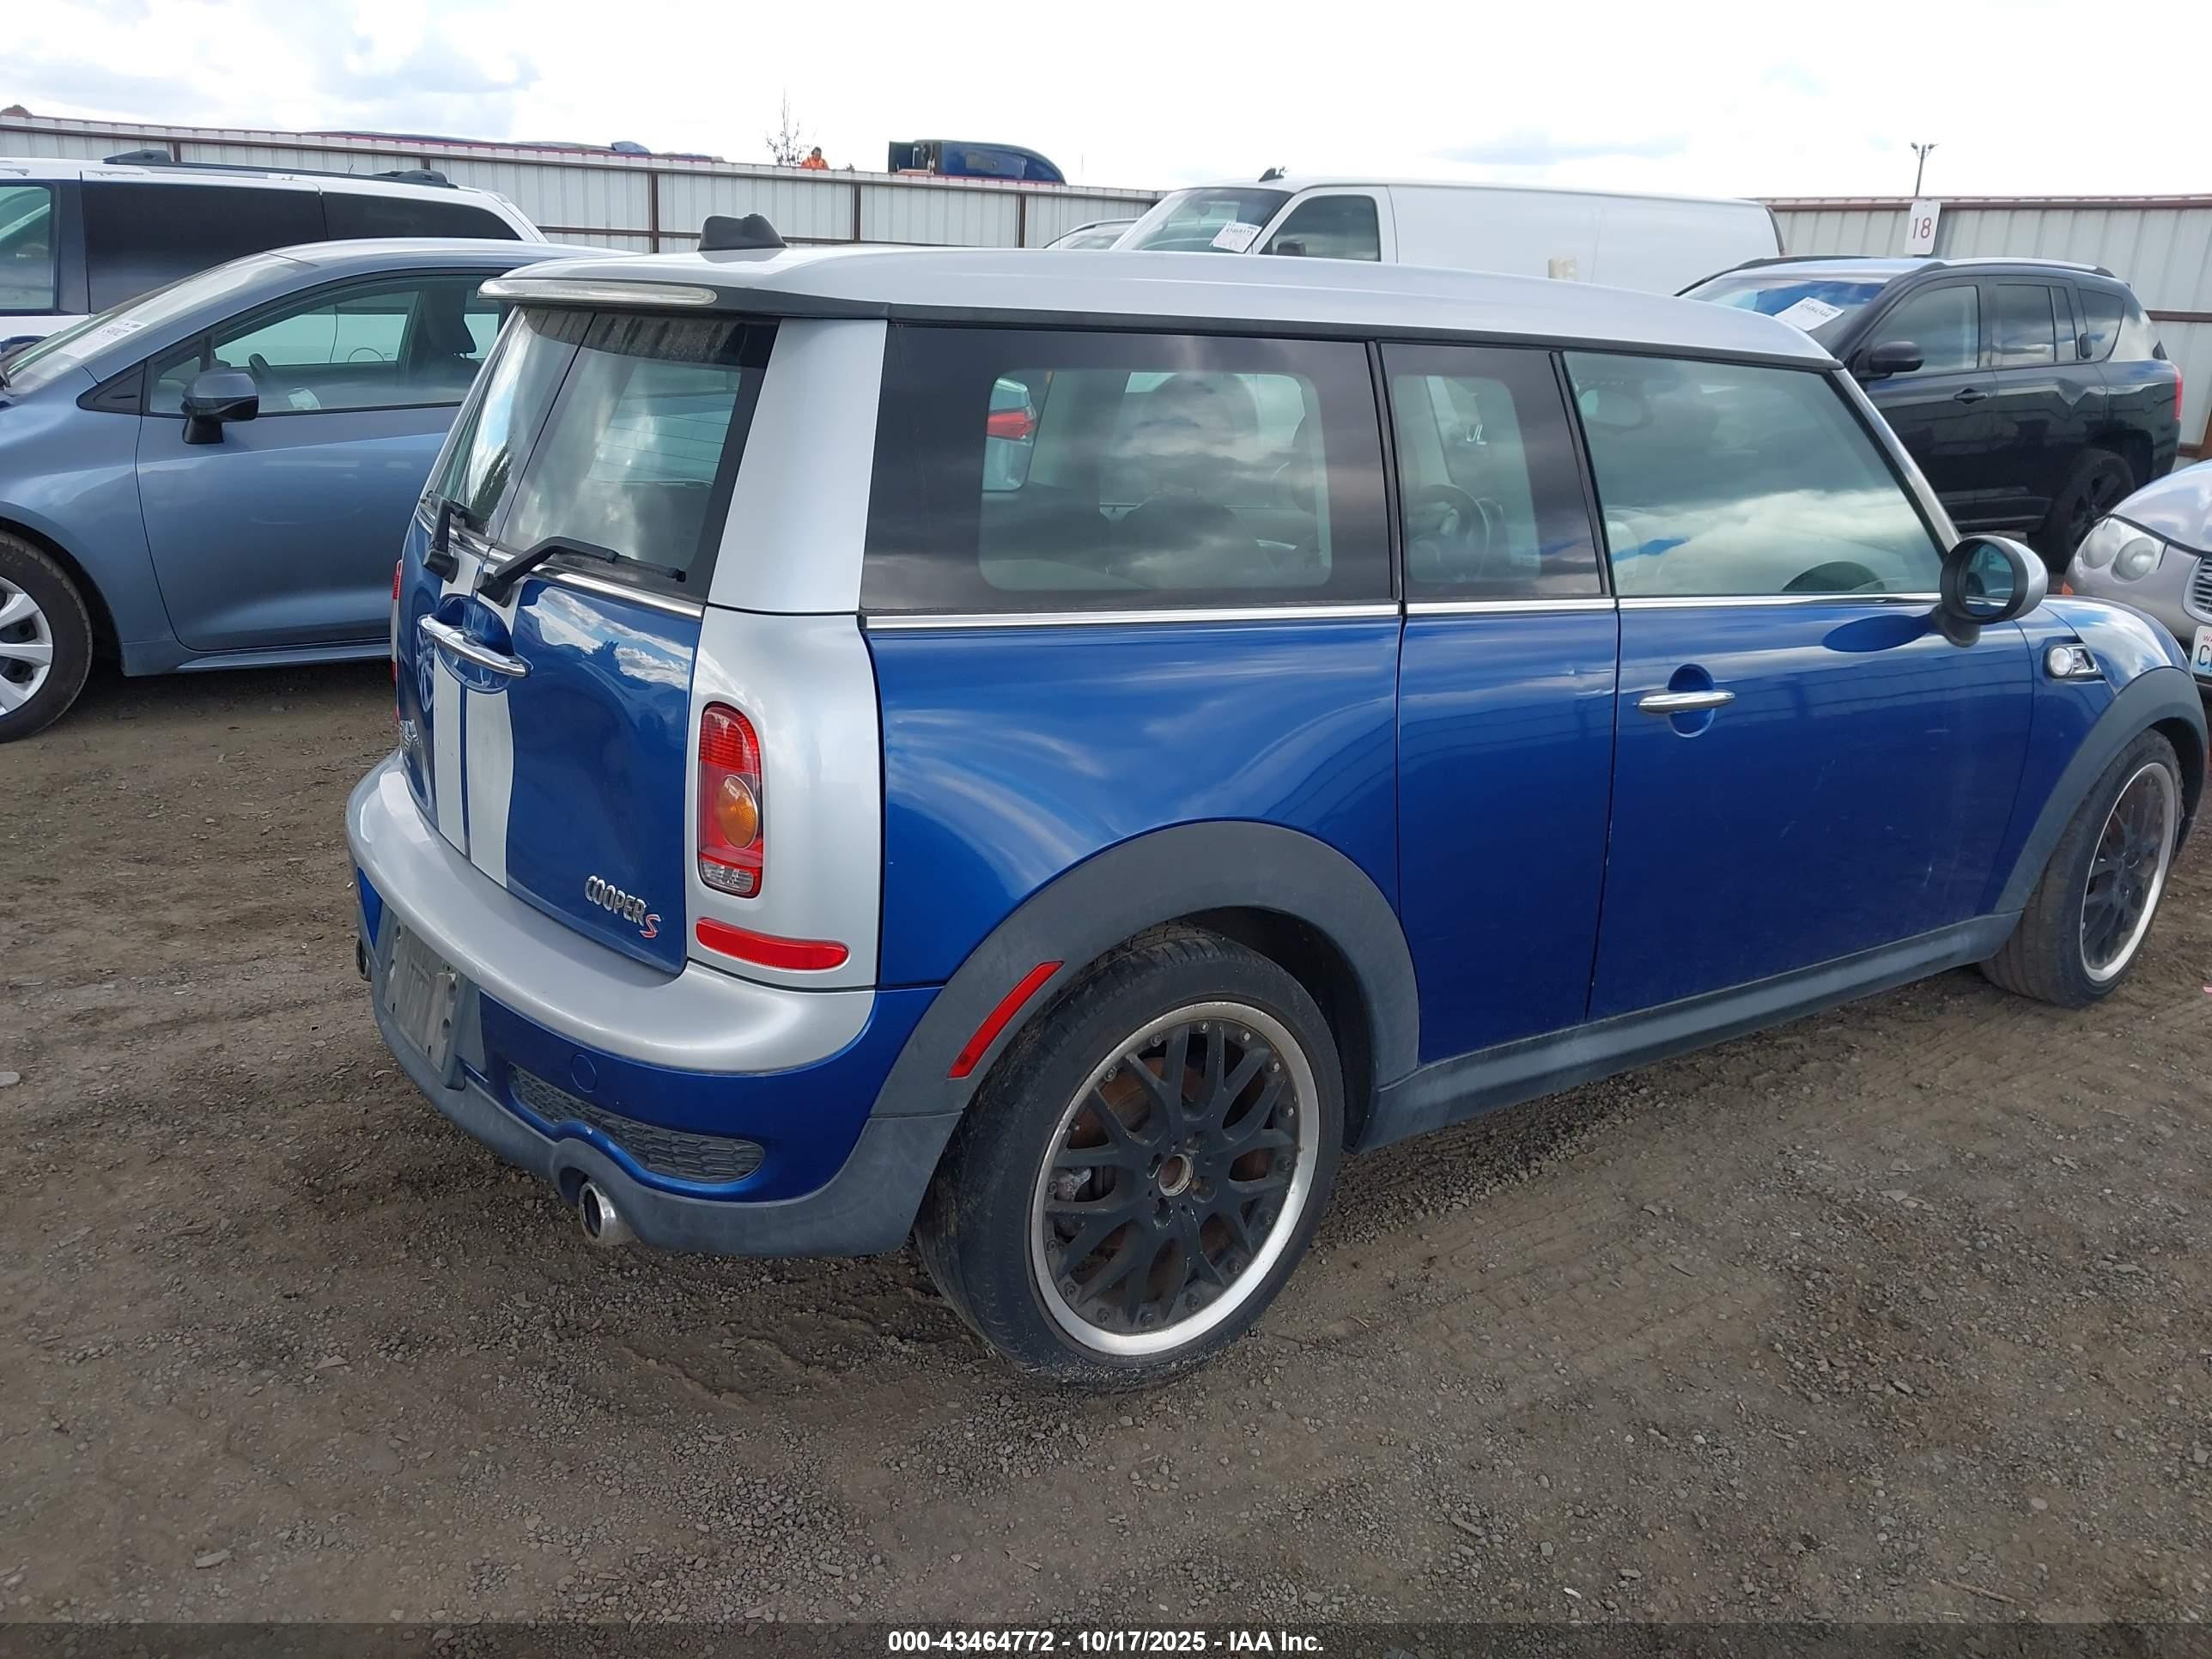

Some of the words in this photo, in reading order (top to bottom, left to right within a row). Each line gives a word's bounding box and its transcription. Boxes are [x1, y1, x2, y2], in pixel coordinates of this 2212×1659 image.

[1912, 216, 1932, 240] 18
[2198, 644, 2212, 669] C
[584, 875, 647, 927] COOPER
[639, 914, 662, 939] S
